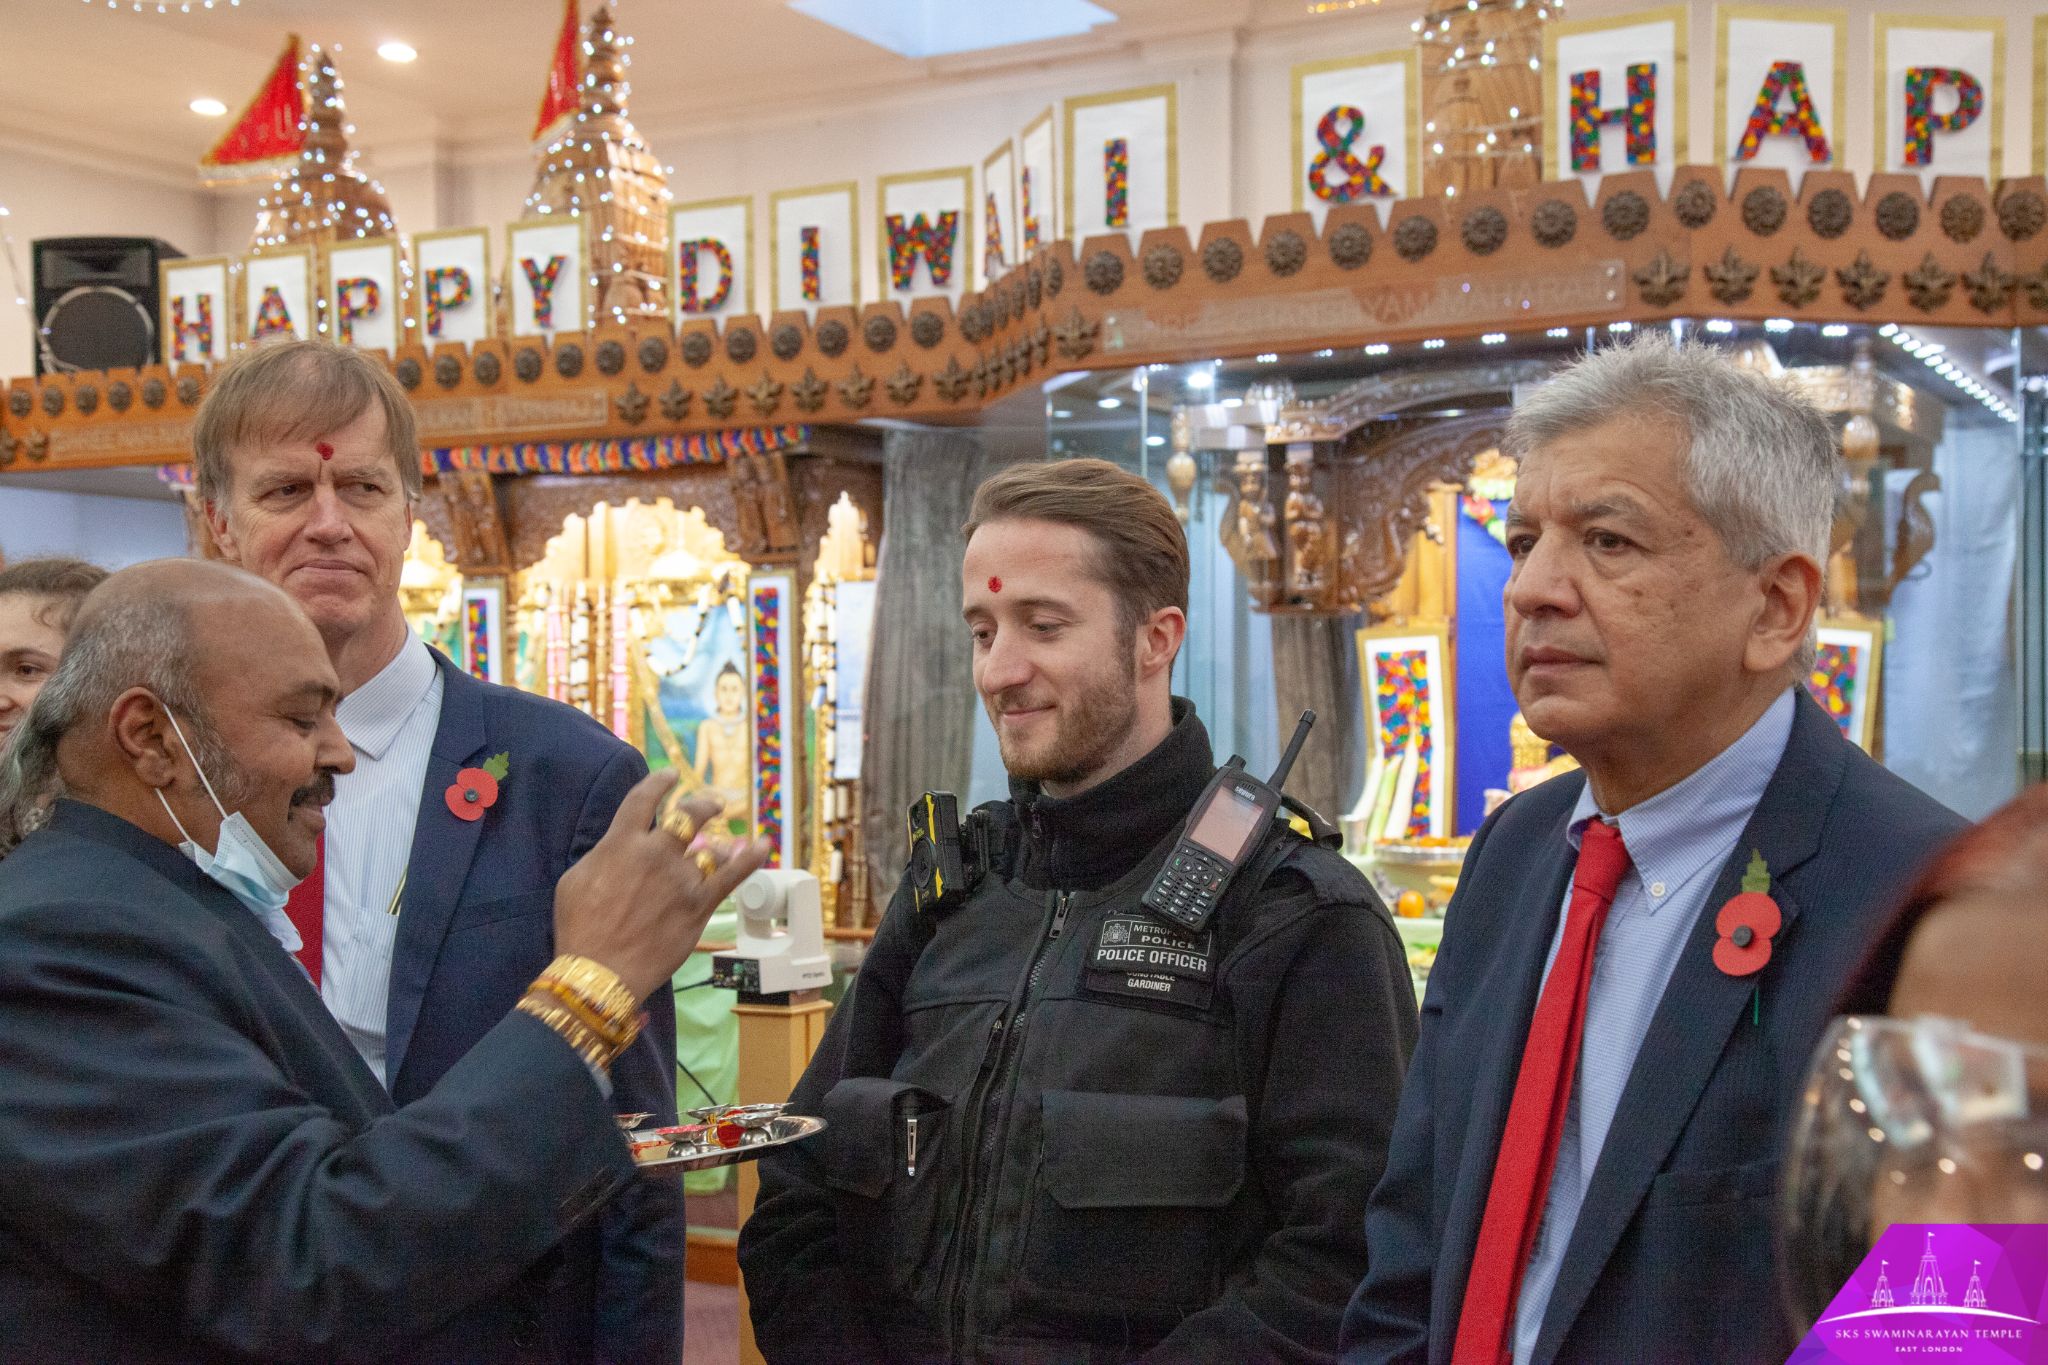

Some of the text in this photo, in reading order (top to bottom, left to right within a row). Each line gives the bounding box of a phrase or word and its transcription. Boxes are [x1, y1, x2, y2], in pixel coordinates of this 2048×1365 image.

[170, 60, 1985, 361] HAPPY DIWALI & HAP
[1141, 935, 1195, 950] POLICE
[1096, 949, 1208, 972] POLICE OFFICER
[1127, 978, 1171, 992] GARDINER
